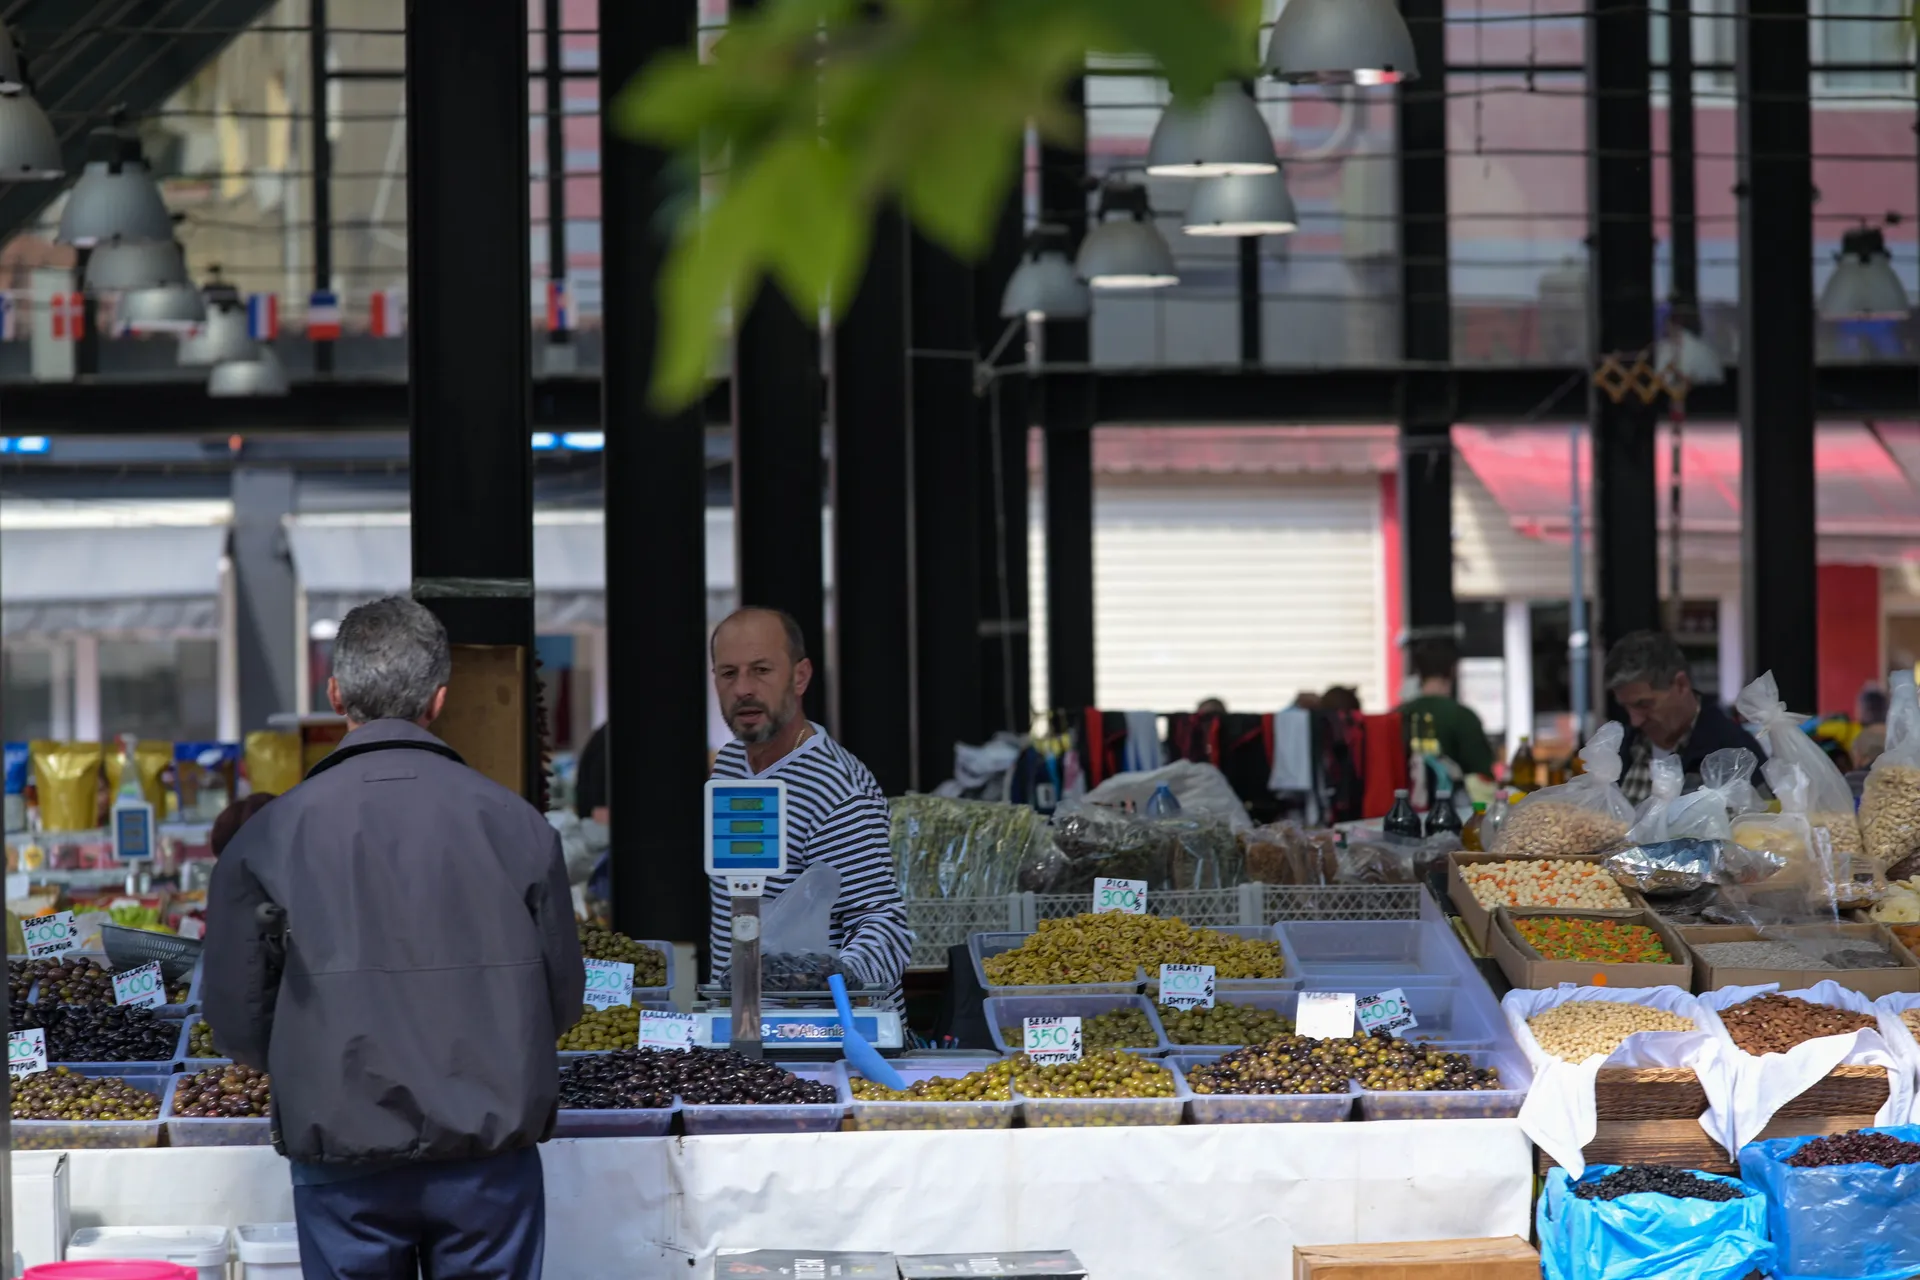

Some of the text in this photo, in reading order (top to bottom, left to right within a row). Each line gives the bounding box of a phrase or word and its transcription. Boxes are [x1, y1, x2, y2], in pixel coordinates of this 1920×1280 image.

[1106, 879, 1129, 888] PICA
[1100, 889, 1136, 908] 300
[25, 914, 56, 928] BERATI
[27, 922, 66, 943] 400
[1167, 964, 1203, 973] BERATI
[1361, 999, 1399, 1023] 400
[1029, 1017, 1062, 1026] BERATI
[9, 1031, 25, 1040] ATI
[799, 1023, 844, 1037] Albania
[1028, 1026, 1068, 1048] 350
[8, 1041, 32, 1058] 00
[9, 1060, 38, 1072] TYPUR
